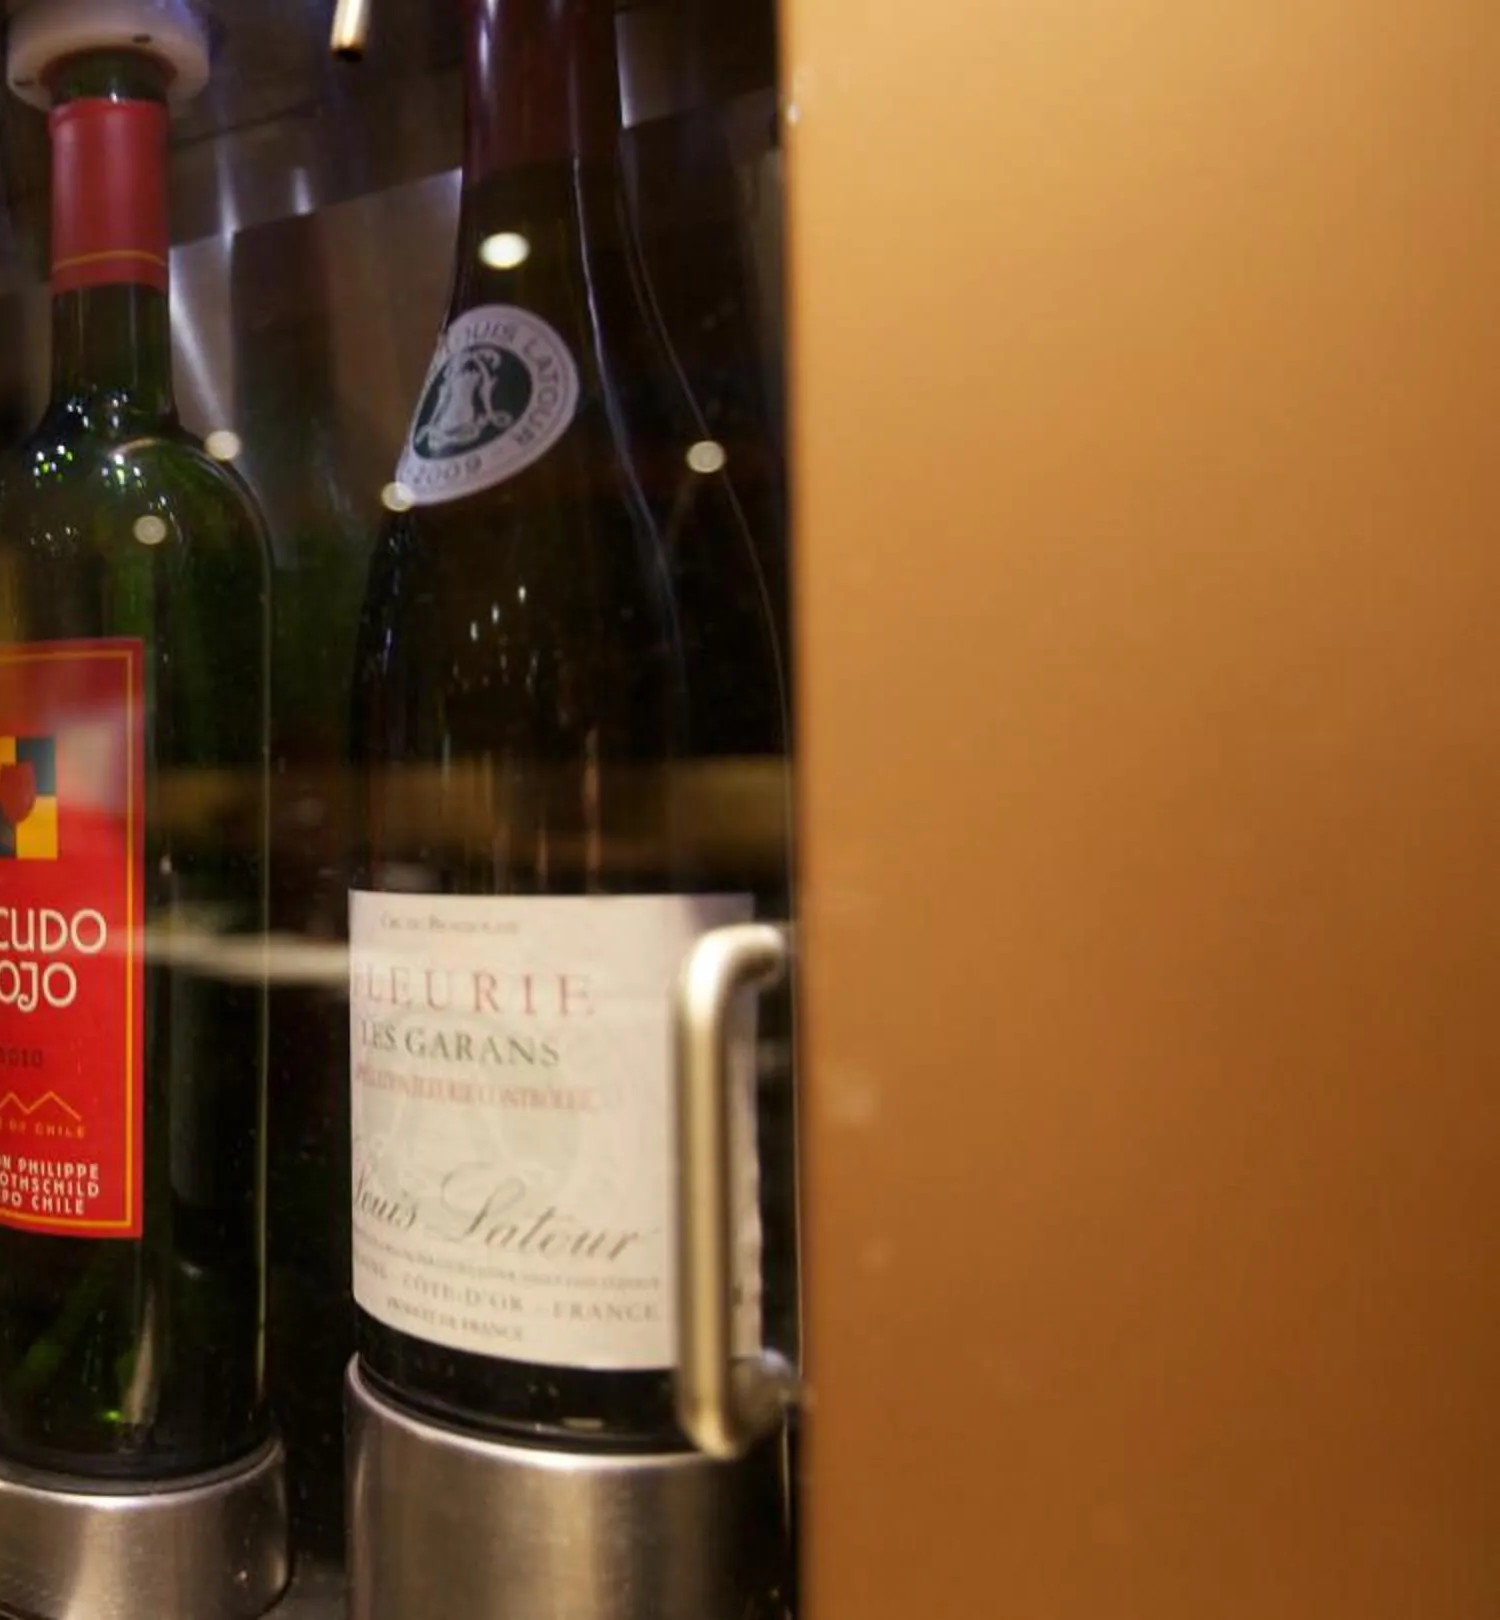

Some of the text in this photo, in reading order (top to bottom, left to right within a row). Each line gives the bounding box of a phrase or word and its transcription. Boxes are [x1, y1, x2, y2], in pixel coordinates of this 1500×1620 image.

[360, 1018, 561, 1069] LES GARANS
[18, 1156, 100, 1181] PHILIPPE
[31, 1192, 86, 1216] CHILE
[428, 1161, 642, 1263] Latour
[551, 1297, 660, 1323] FRANCE
